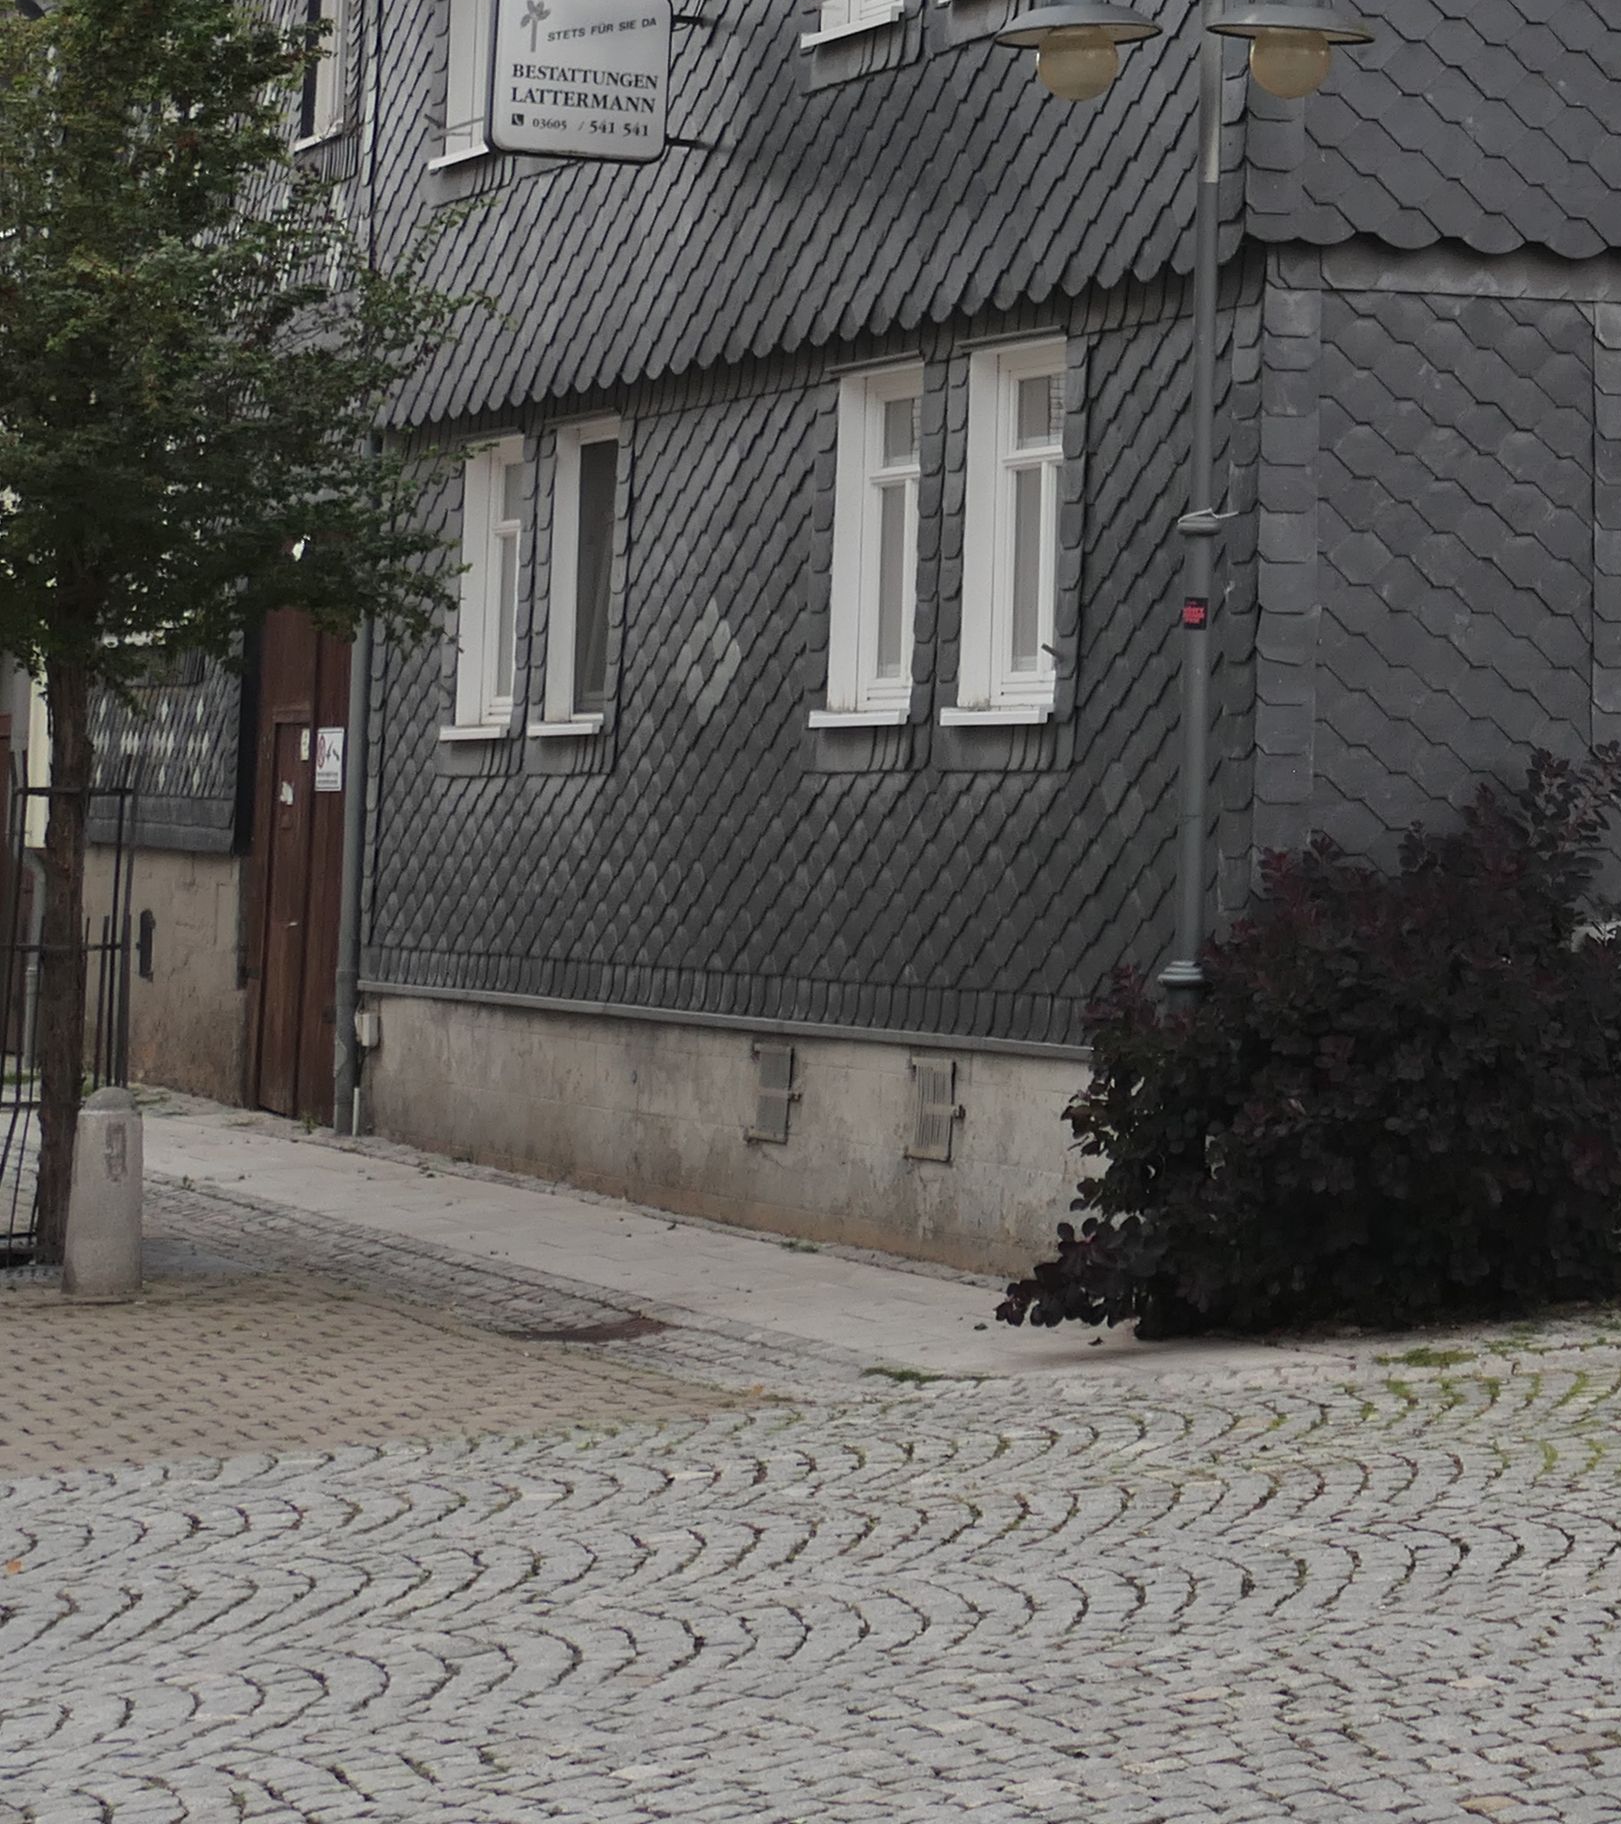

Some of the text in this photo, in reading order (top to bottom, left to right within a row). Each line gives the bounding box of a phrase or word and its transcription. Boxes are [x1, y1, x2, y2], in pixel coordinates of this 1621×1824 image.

[547, 17, 657, 42] STETS FÜR SIE DA
[512, 63, 659, 90] BESTATTUNGEN
[511, 86, 656, 114] LATTERMANN
[532, 117, 568, 132] 03605
[589, 119, 616, 135] 541
[622, 122, 649, 137] 541
